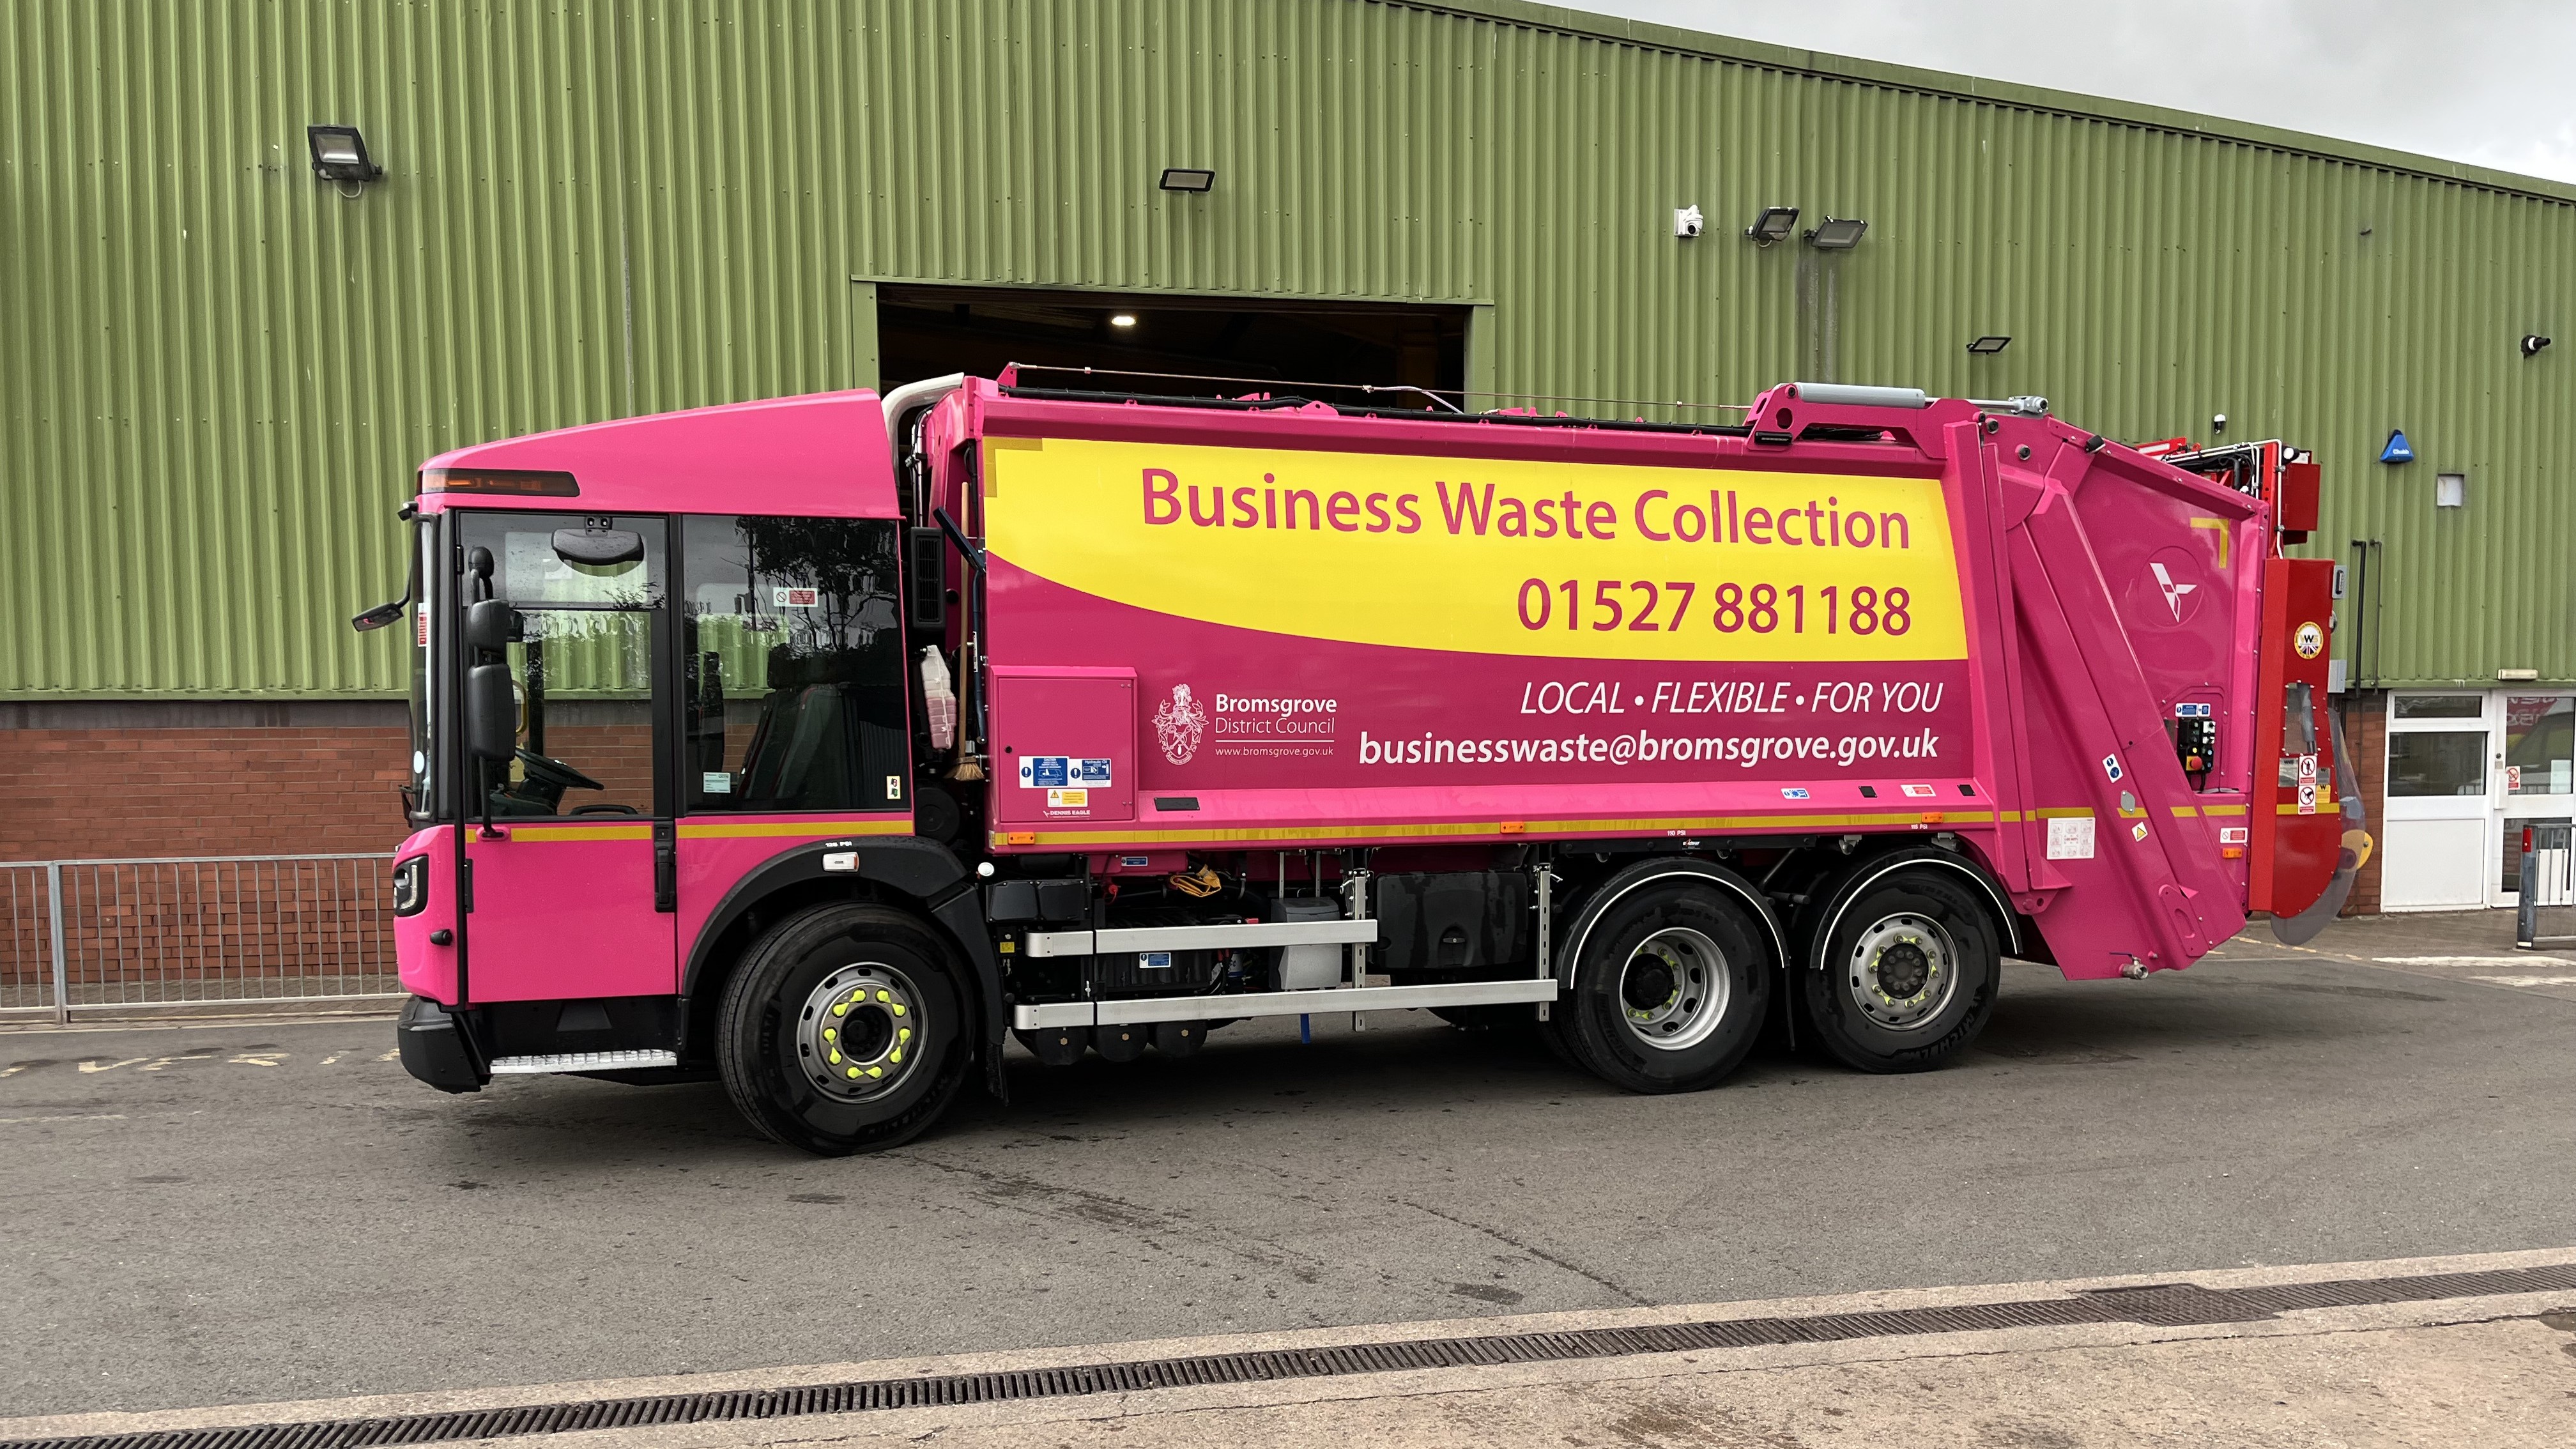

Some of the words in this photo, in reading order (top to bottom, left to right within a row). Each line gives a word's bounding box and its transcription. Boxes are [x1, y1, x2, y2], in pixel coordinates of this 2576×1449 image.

[1142, 468, 1422, 534] Business
[1435, 481, 1617, 540] Waste
[1634, 489, 1909, 549] Collection
[1517, 578, 1696, 632] 01527
[1713, 582, 1911, 636] 881188
[1216, 694, 1337, 717] Bromsgrove
[1521, 682, 1625, 714] LOCAL
[1654, 682, 1791, 714] FLEXIBLE
[1811, 682, 1873, 713] FOR
[1882, 682, 1943, 712] YOU
[1215, 717, 1271, 733] District
[1275, 717, 1335, 733] Council
[1215, 746, 1333, 758] www.bromsgrove.gov.uk
[1359, 728, 1940, 768] businesswaste@bromsgrove.gov.uk
